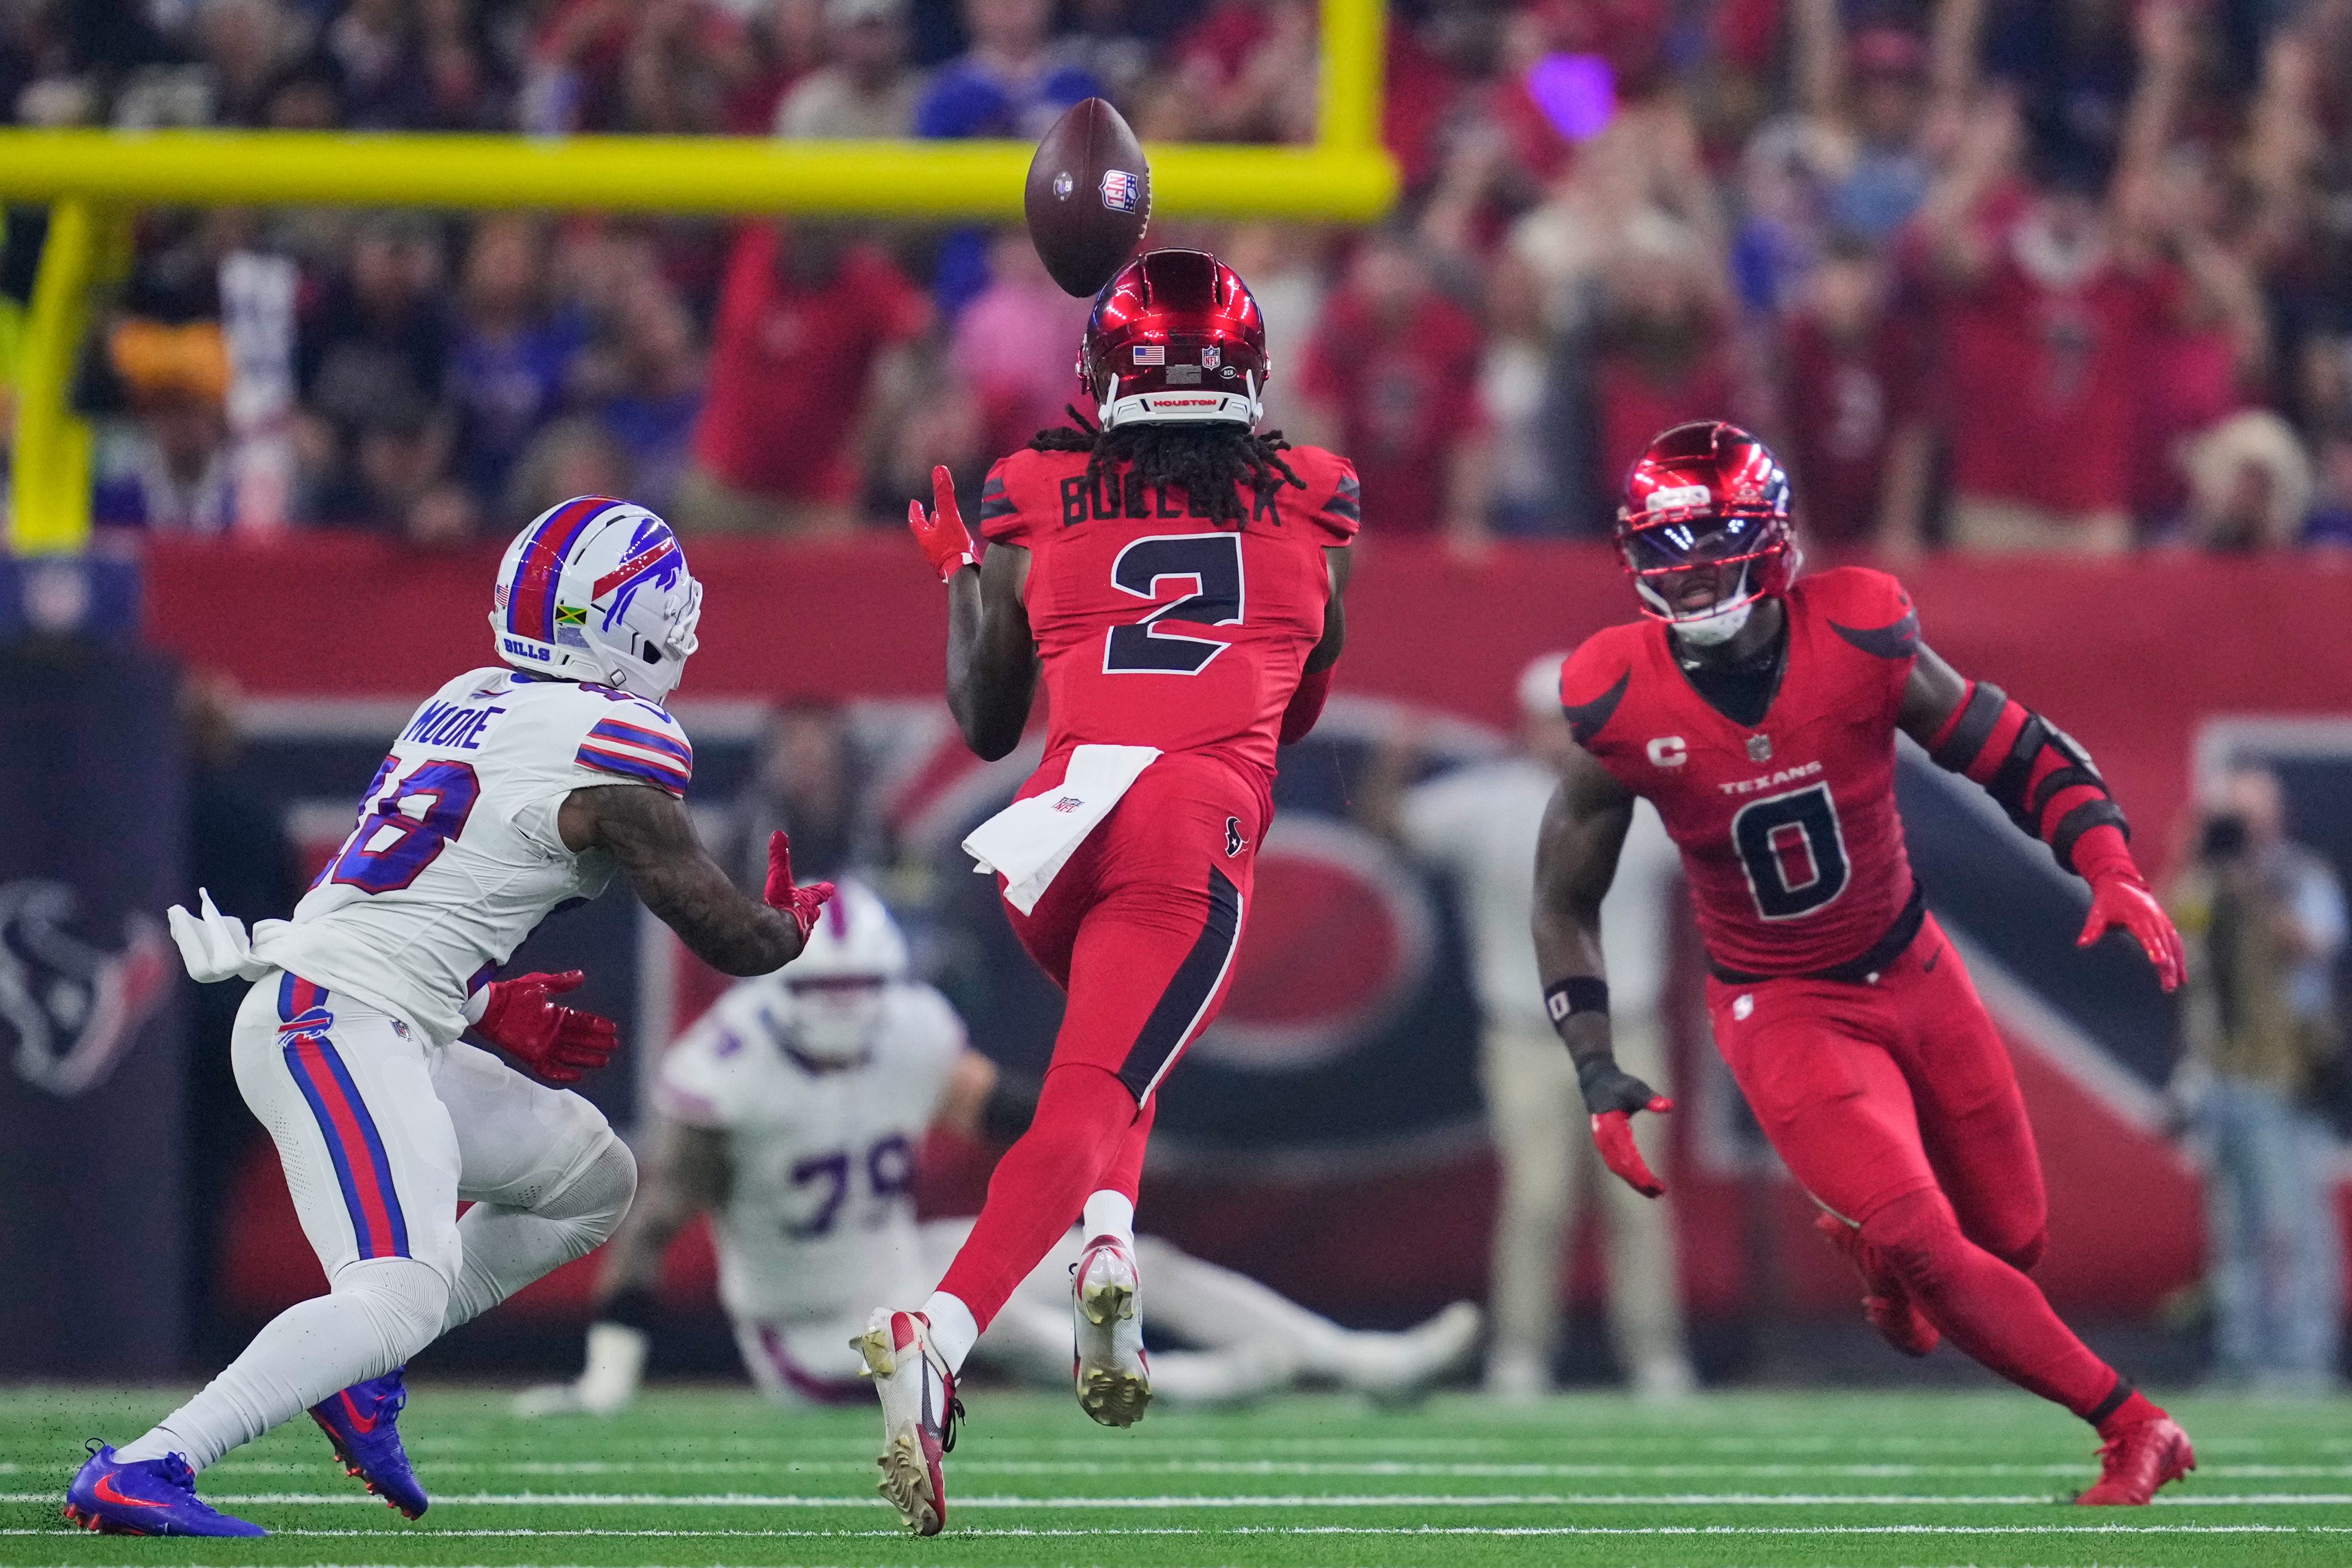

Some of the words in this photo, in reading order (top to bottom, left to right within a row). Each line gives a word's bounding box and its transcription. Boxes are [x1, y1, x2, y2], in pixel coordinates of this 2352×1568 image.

[1106, 175, 1125, 205] NFL
[1206, 357, 1218, 366] NFL
[1102, 532, 1245, 676] 2
[504, 638, 551, 662] BILLS
[403, 699, 507, 749] MOORE
[1646, 736, 1688, 767] C
[1718, 760, 1823, 795] TEXANS
[1054, 803, 1075, 813] NFL
[1731, 780, 1851, 921] 0
